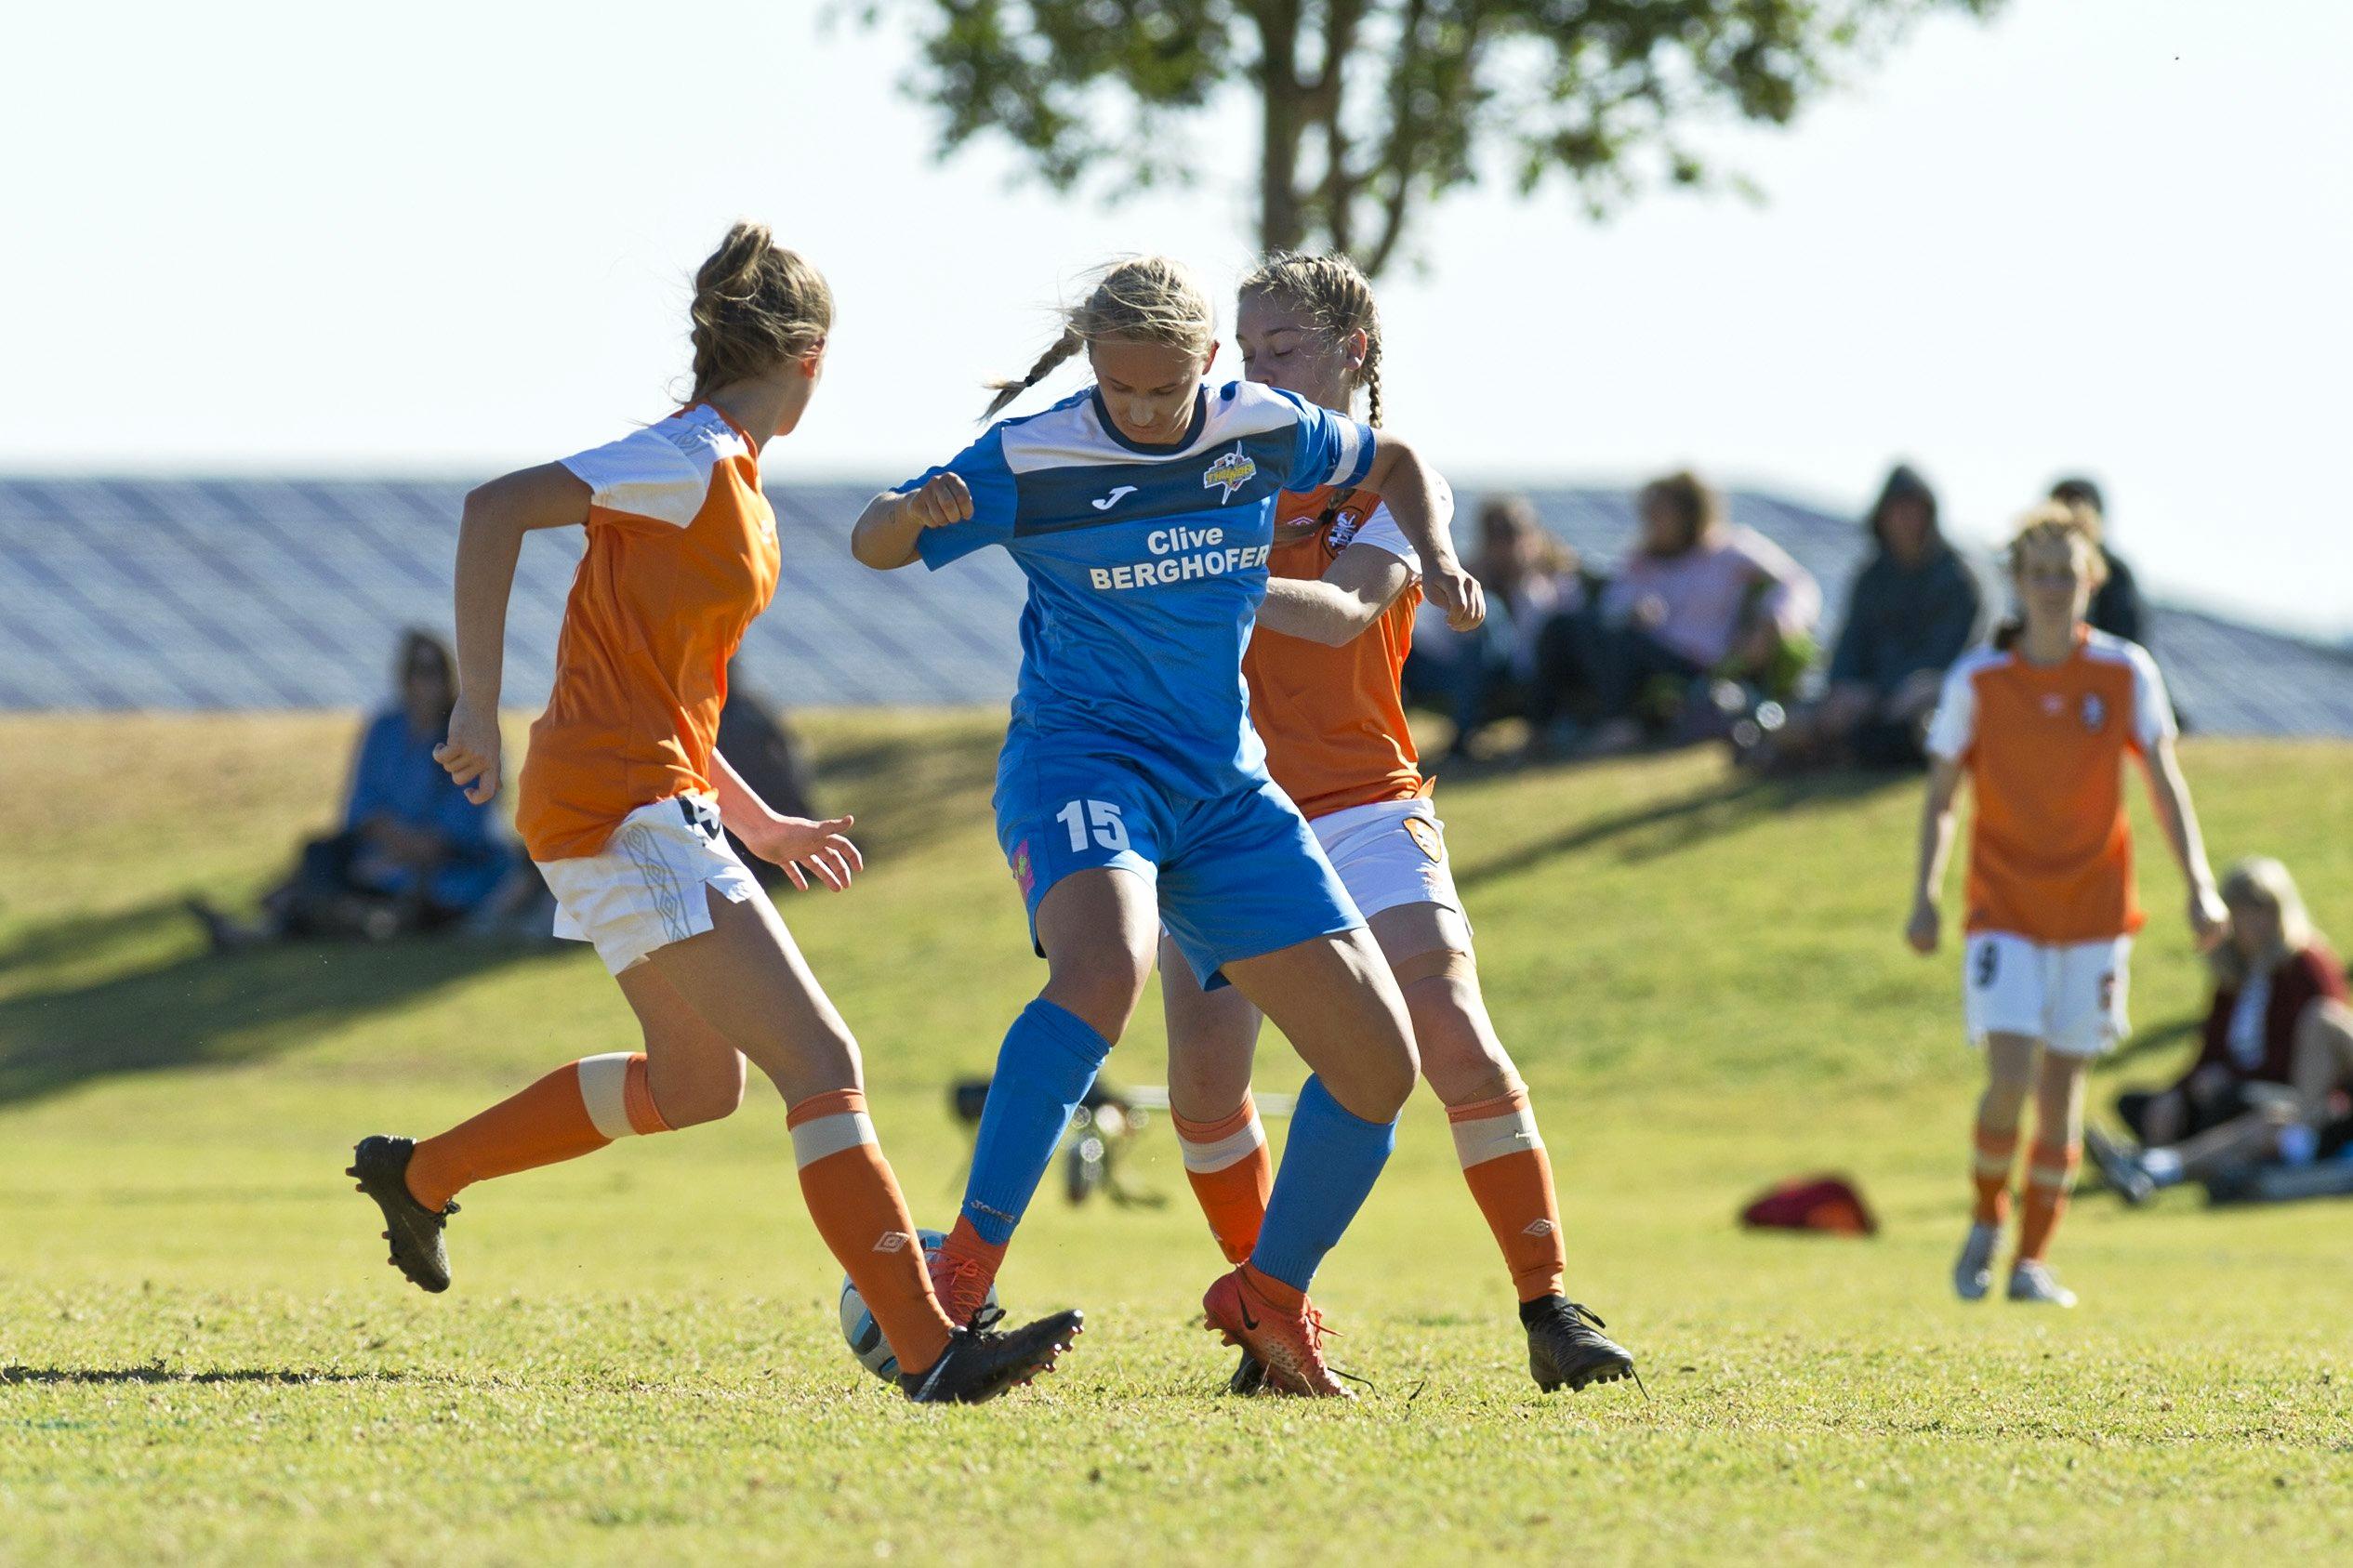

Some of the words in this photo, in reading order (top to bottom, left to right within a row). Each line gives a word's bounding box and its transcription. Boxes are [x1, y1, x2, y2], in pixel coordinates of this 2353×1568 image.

[1147, 526, 1223, 555] Clive
[1090, 545, 1270, 590] BERGHOFER
[1056, 799, 1130, 852] 15
